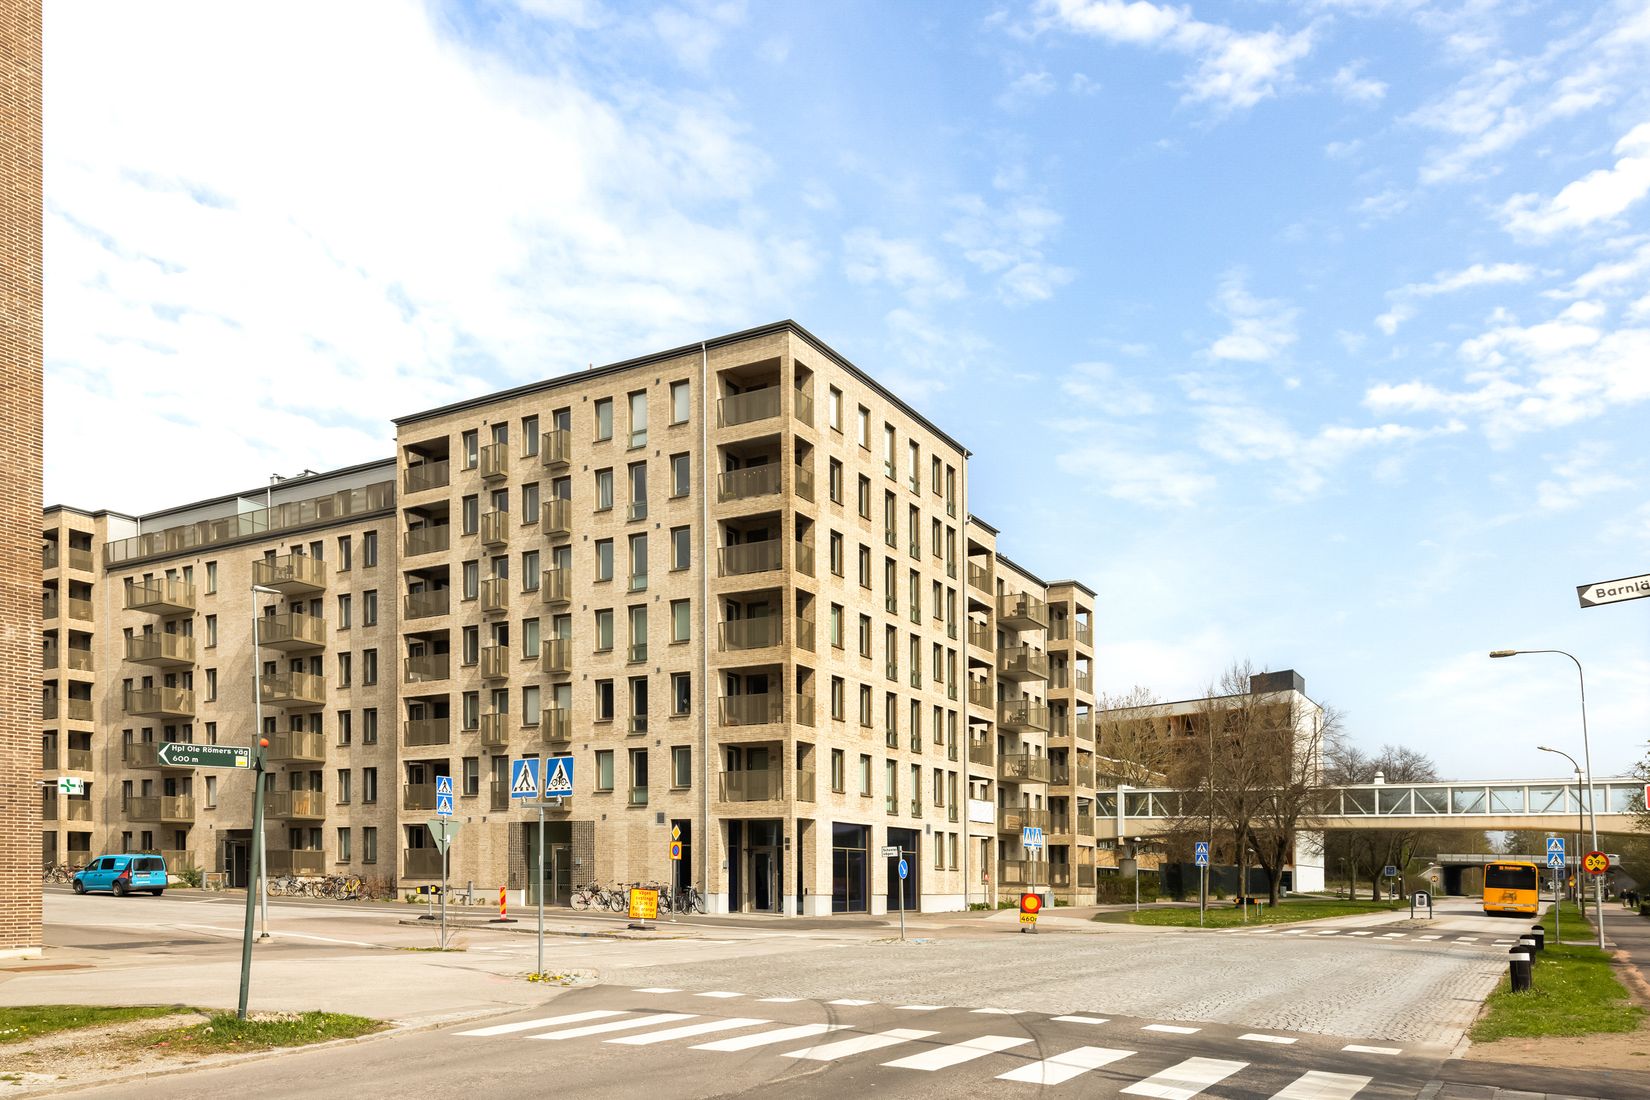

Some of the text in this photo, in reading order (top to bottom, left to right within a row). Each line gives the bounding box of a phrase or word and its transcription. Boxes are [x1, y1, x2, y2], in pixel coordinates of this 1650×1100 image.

[1595, 580, 1650, 598] Barnlä
[171, 745, 185, 753] Hpl
[187, 745, 200, 753] Ole
[202, 746, 231, 754] Römers
